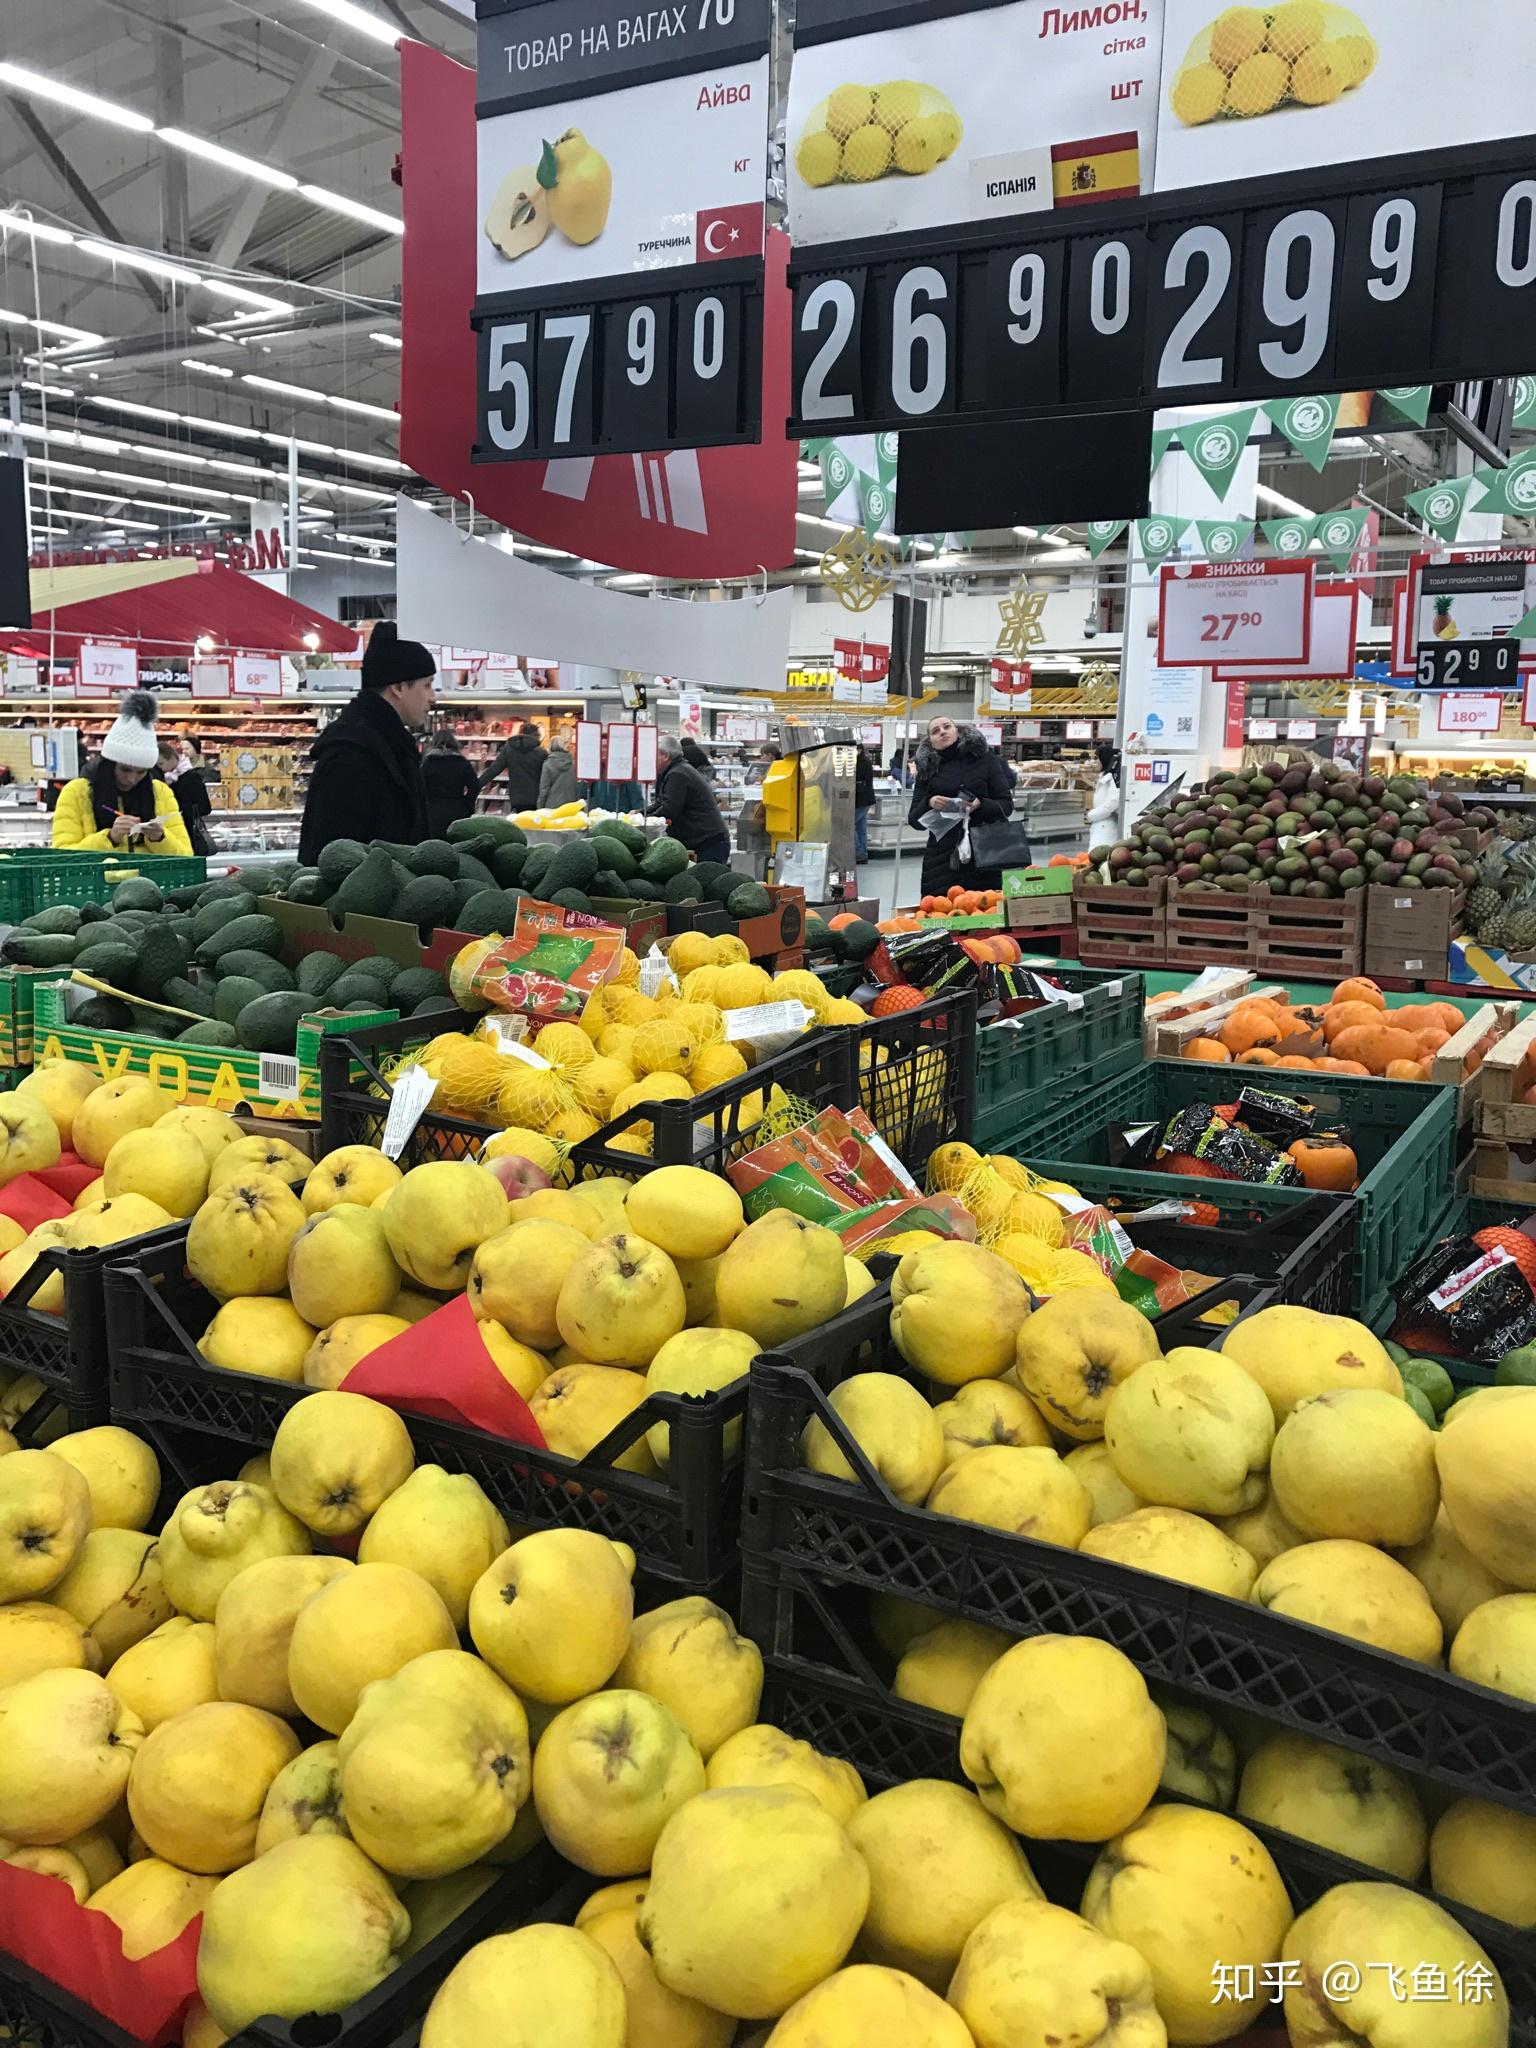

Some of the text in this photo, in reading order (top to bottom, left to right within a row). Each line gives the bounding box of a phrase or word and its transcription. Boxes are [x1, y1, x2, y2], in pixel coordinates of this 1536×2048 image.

[1038, 0, 1148, 39] Лимон,
[504, 33, 573, 72] ТОВАР
[581, 24, 610, 57] НА
[617, 5, 688, 48] ВАГАХ
[1103, 35, 1147, 56] сітка
[696, 83, 751, 111] Айва
[1111, 79, 1143, 101] шт
[734, 158, 751, 173] кг
[986, 176, 1036, 198] ІСПАНІЯ
[638, 235, 691, 253] ТУРЕЧЧИНА
[1156, 209, 1336, 389] 29
[801, 266, 948, 421] 26
[487, 314, 591, 450] 57
[1205, 562, 1266, 577] ЗНИЖКИ
[1417, 649, 1462, 686] 52
